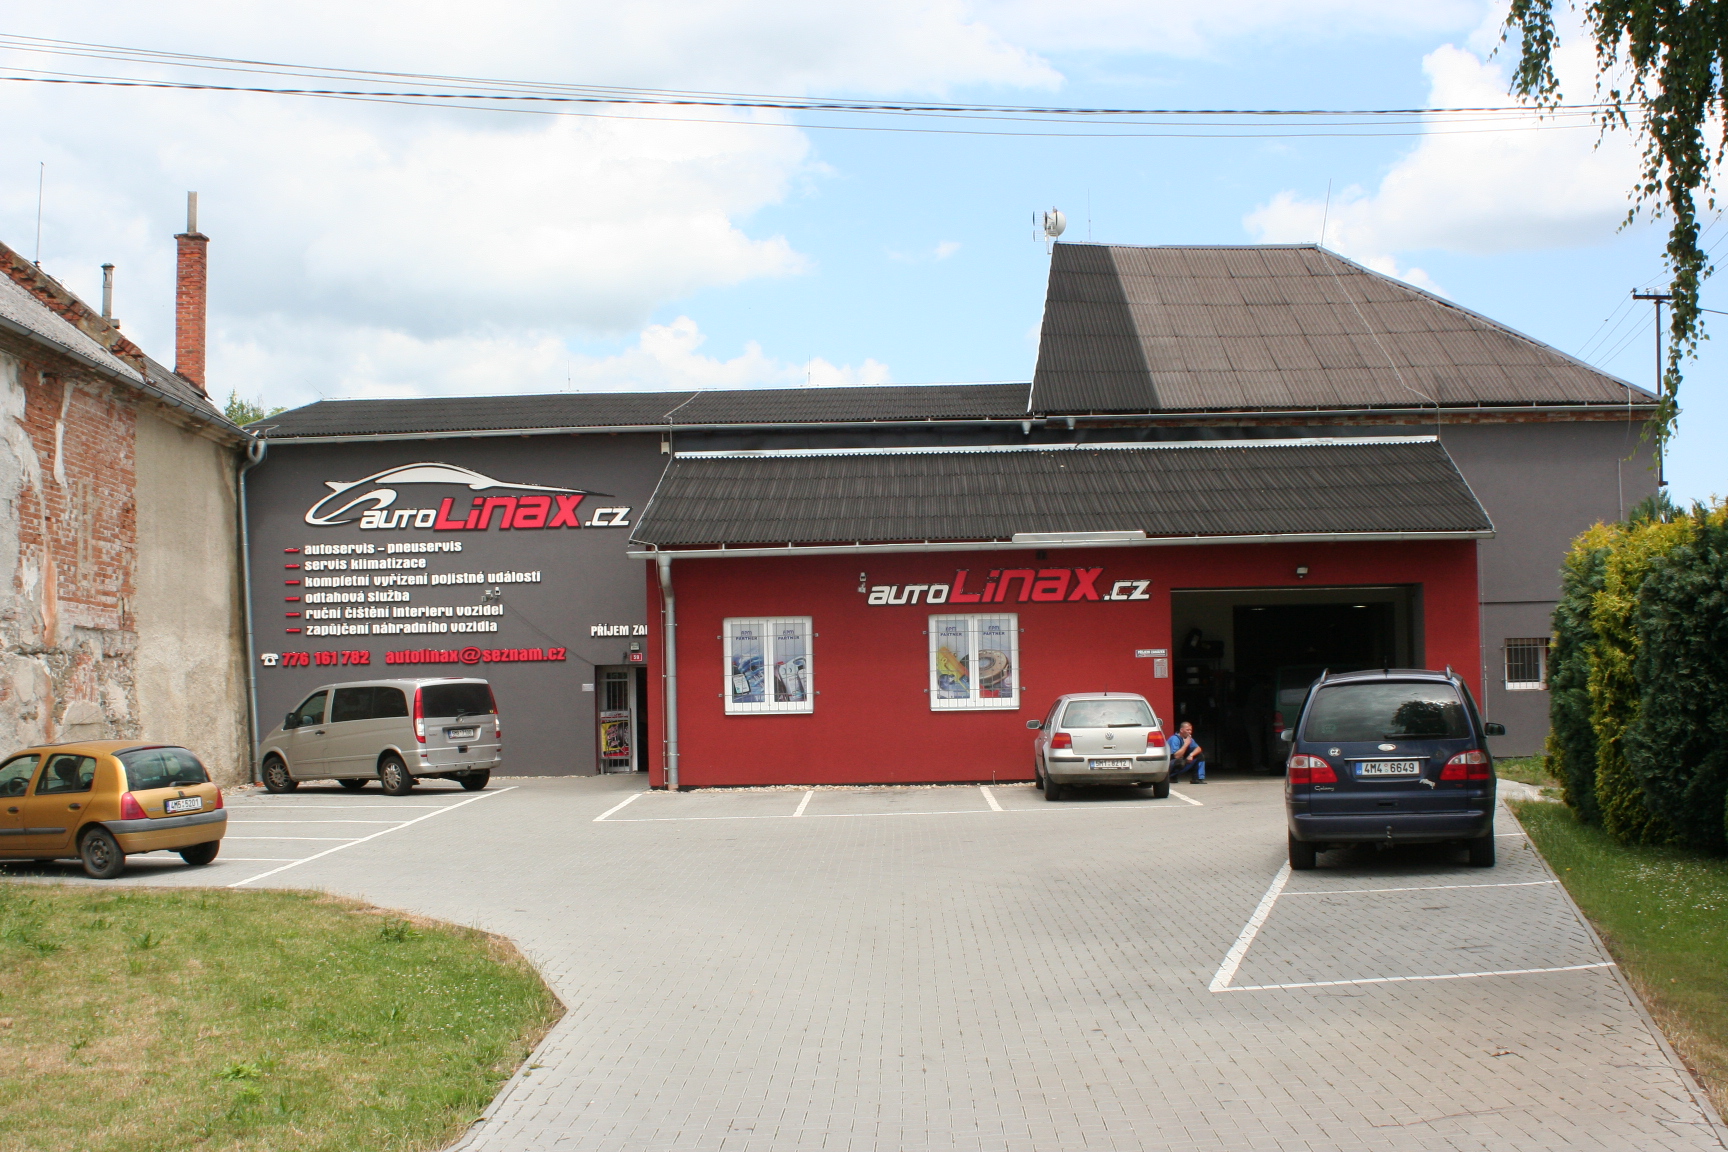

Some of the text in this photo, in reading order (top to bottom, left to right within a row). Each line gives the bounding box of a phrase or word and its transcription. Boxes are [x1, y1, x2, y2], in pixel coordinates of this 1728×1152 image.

[304, 542, 375, 555] autoservis
[387, 540, 462, 554] pneuservis
[304, 557, 427, 571] servis klimatizace
[304, 569, 541, 588] kompletní vyřízení pojistné události
[305, 589, 410, 604] odtahová služba
[305, 603, 503, 620] ruční čištění interieru vozidel
[306, 620, 498, 637] zapůjčení náhradního vozidla
[590, 623, 630, 637] PŘÍJEM
[281, 650, 370, 666] 776 161 782
[385, 646, 566, 664] autolinax@seznam.cz
[1364, 762, 1415, 774] 4M4 6649
